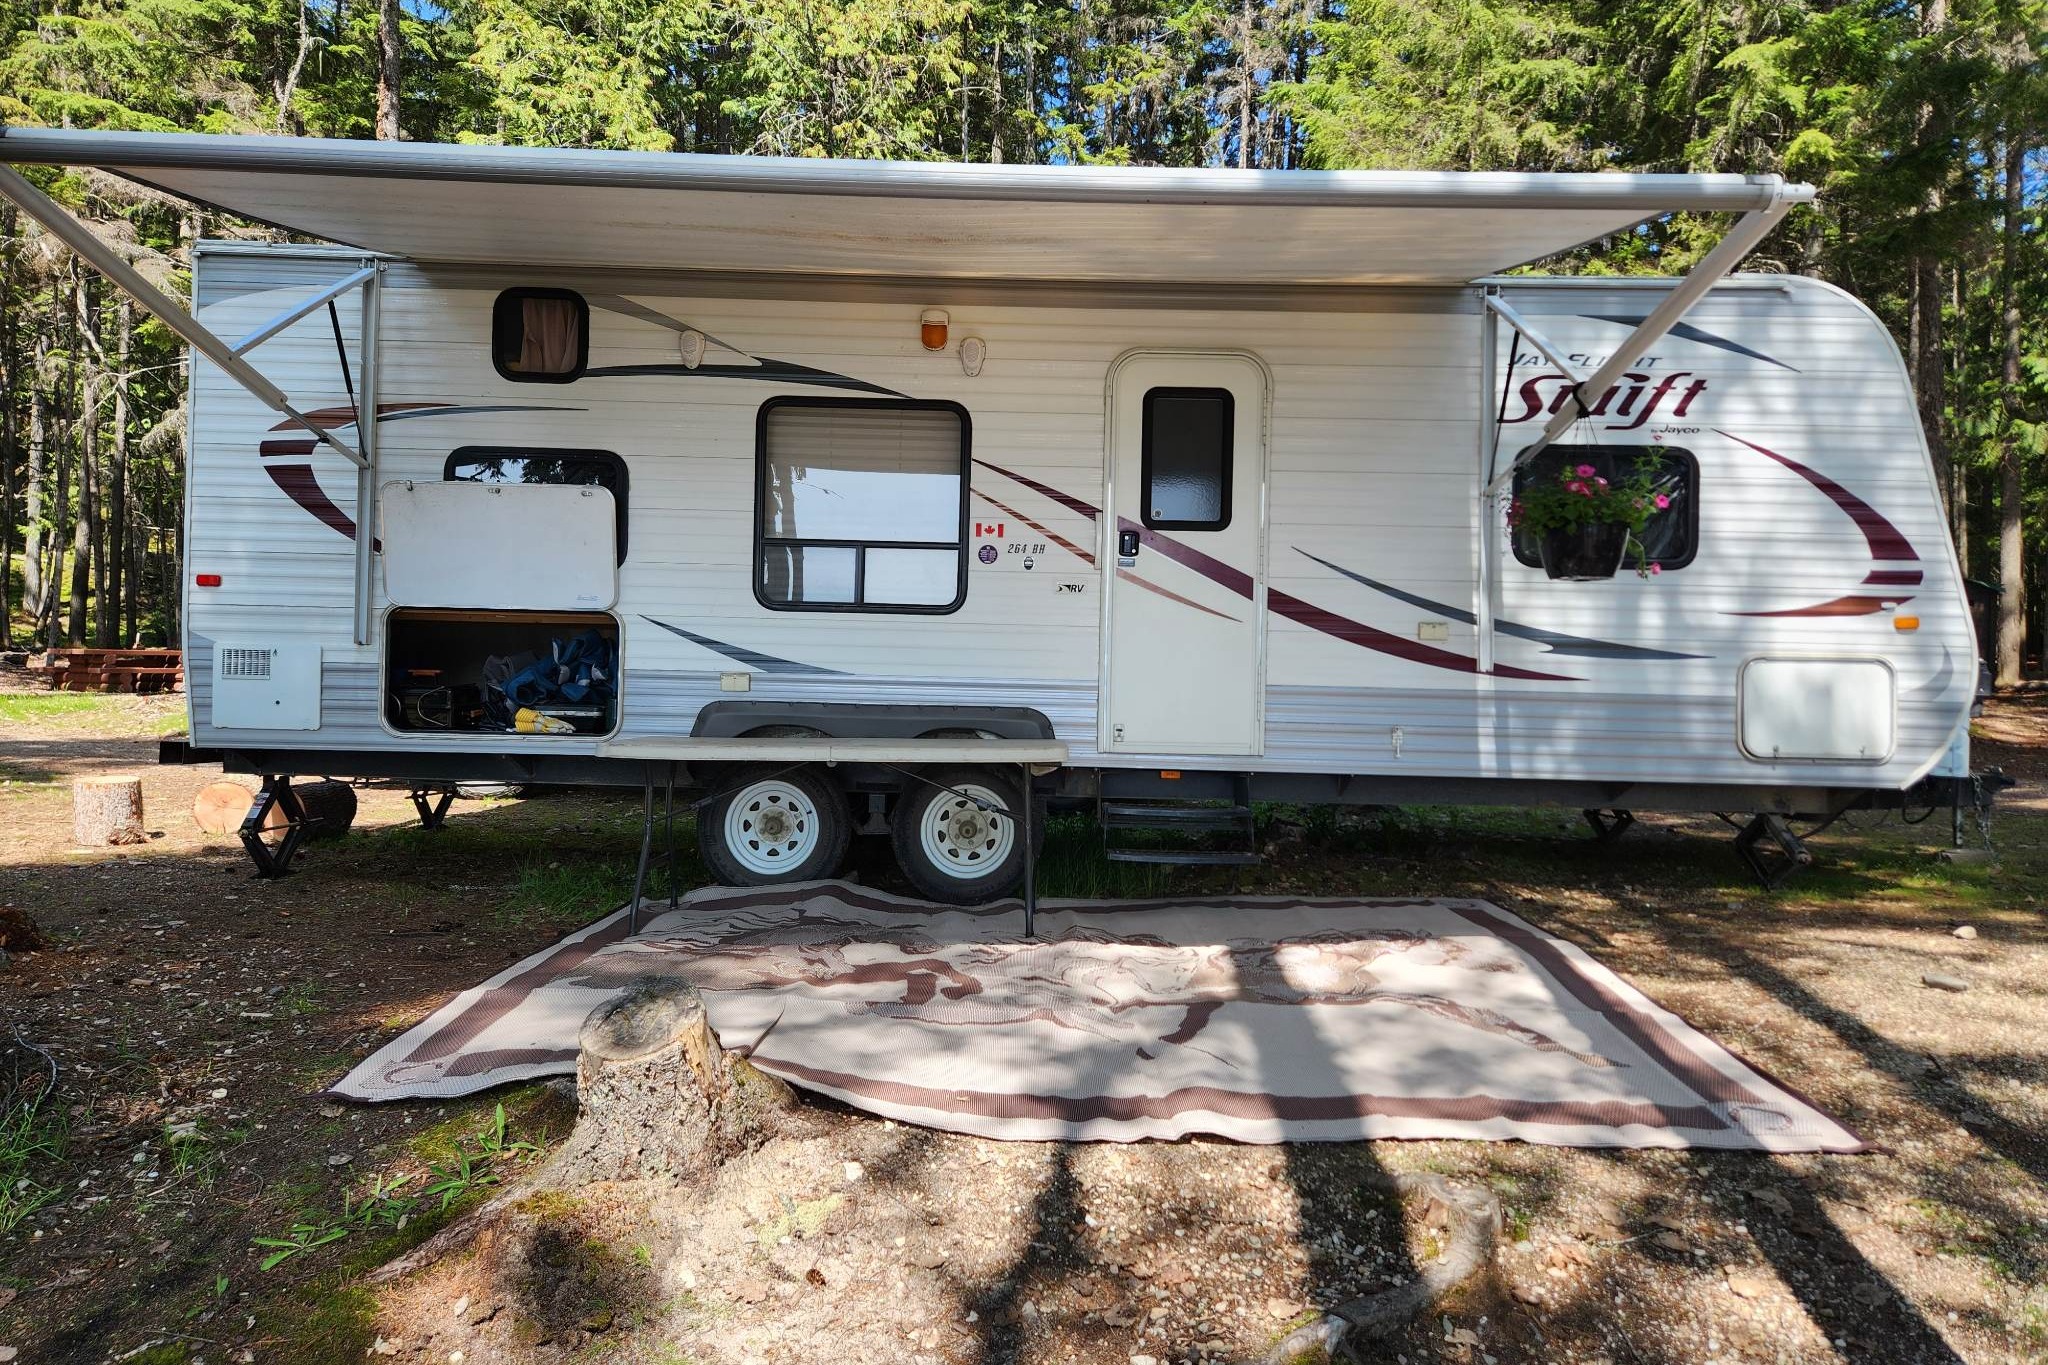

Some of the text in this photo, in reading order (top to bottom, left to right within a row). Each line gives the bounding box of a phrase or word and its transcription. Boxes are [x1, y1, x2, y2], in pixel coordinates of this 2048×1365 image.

[1659, 423, 1700, 435] Jayco
[1007, 543, 1046, 554] 264 BH
[1070, 584, 1085, 593] RV
